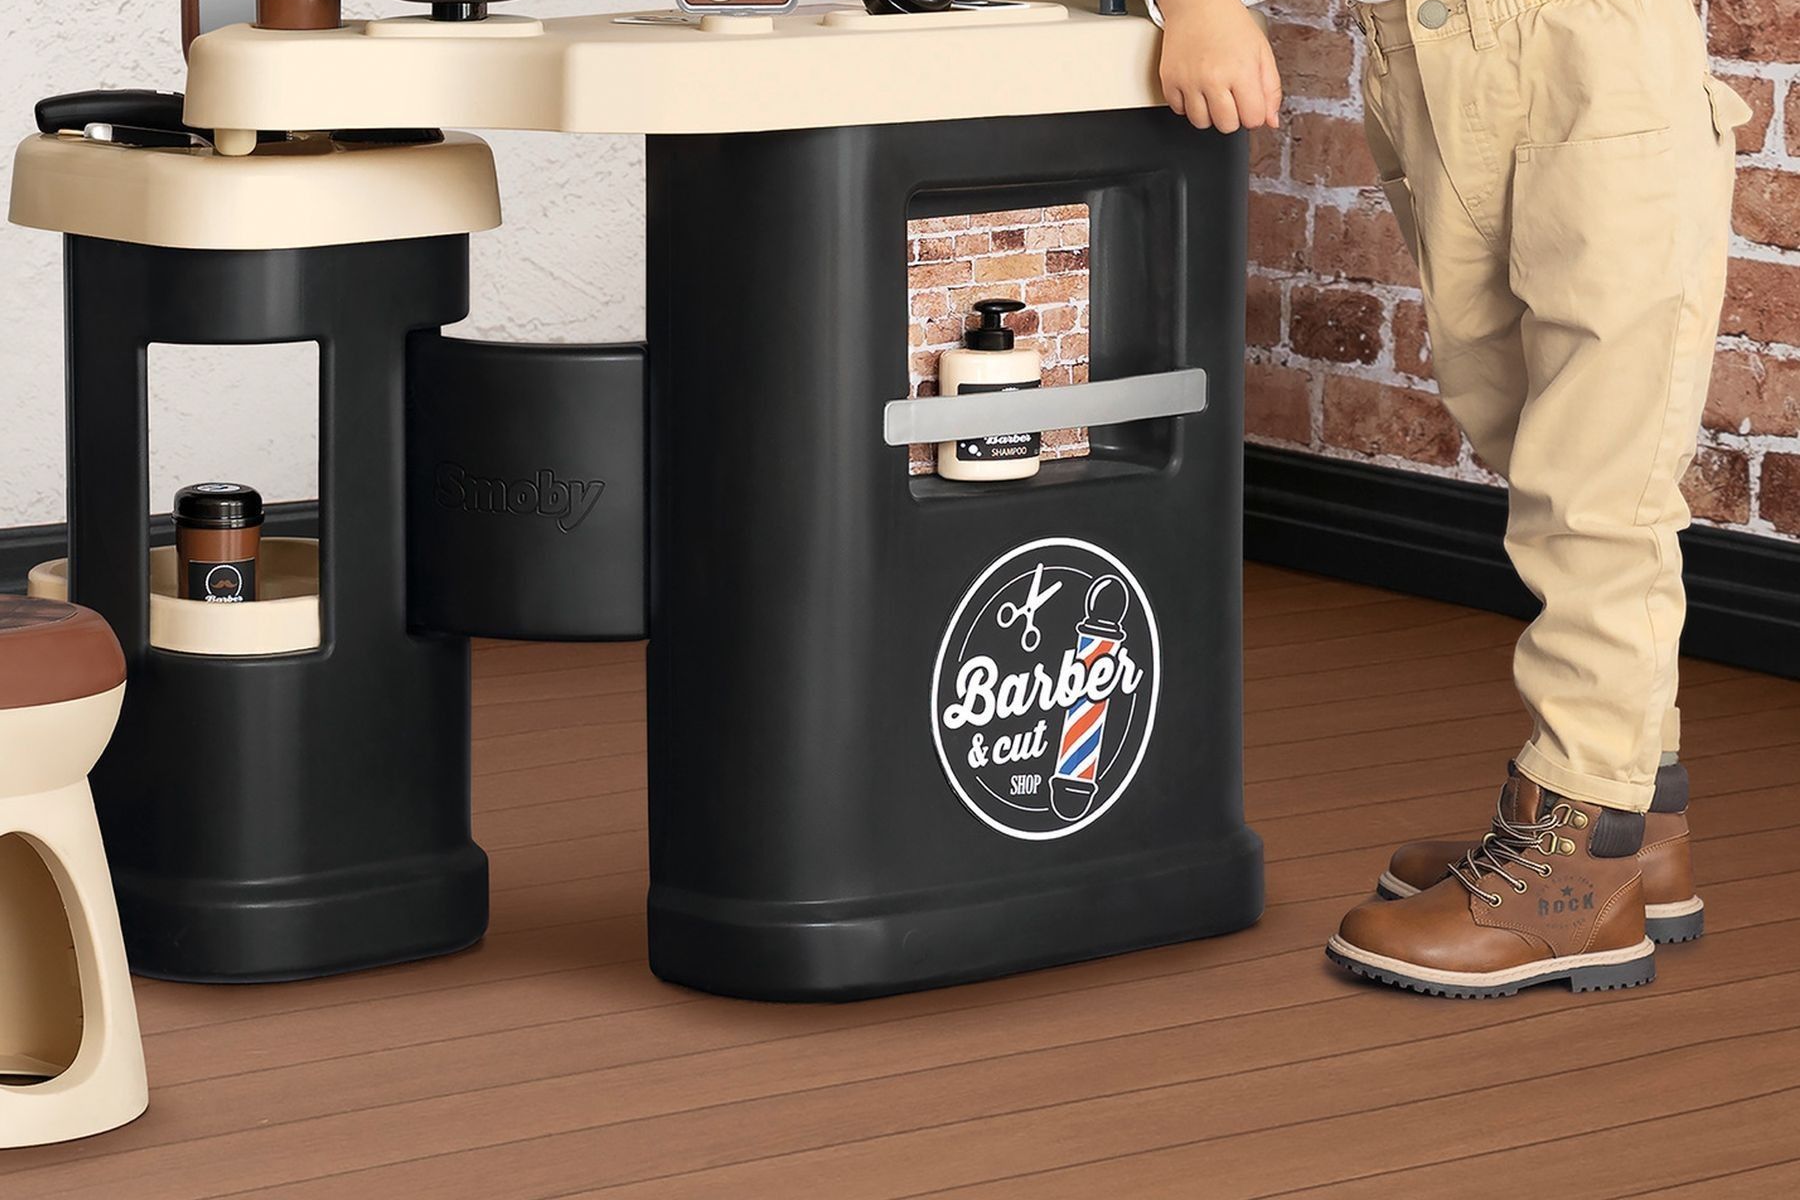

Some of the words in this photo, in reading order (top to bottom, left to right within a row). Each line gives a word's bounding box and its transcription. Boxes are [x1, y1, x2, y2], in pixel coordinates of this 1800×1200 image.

[984, 434, 1032, 445] Barber
[991, 447, 1027, 457] SHAMPOO
[435, 461, 606, 535] Smoby
[943, 647, 1143, 729] Barber
[967, 732, 989, 769] &
[991, 720, 1048, 764] cut
[1010, 774, 1041, 795] SHOP
[1538, 892, 1594, 917] ROCK
